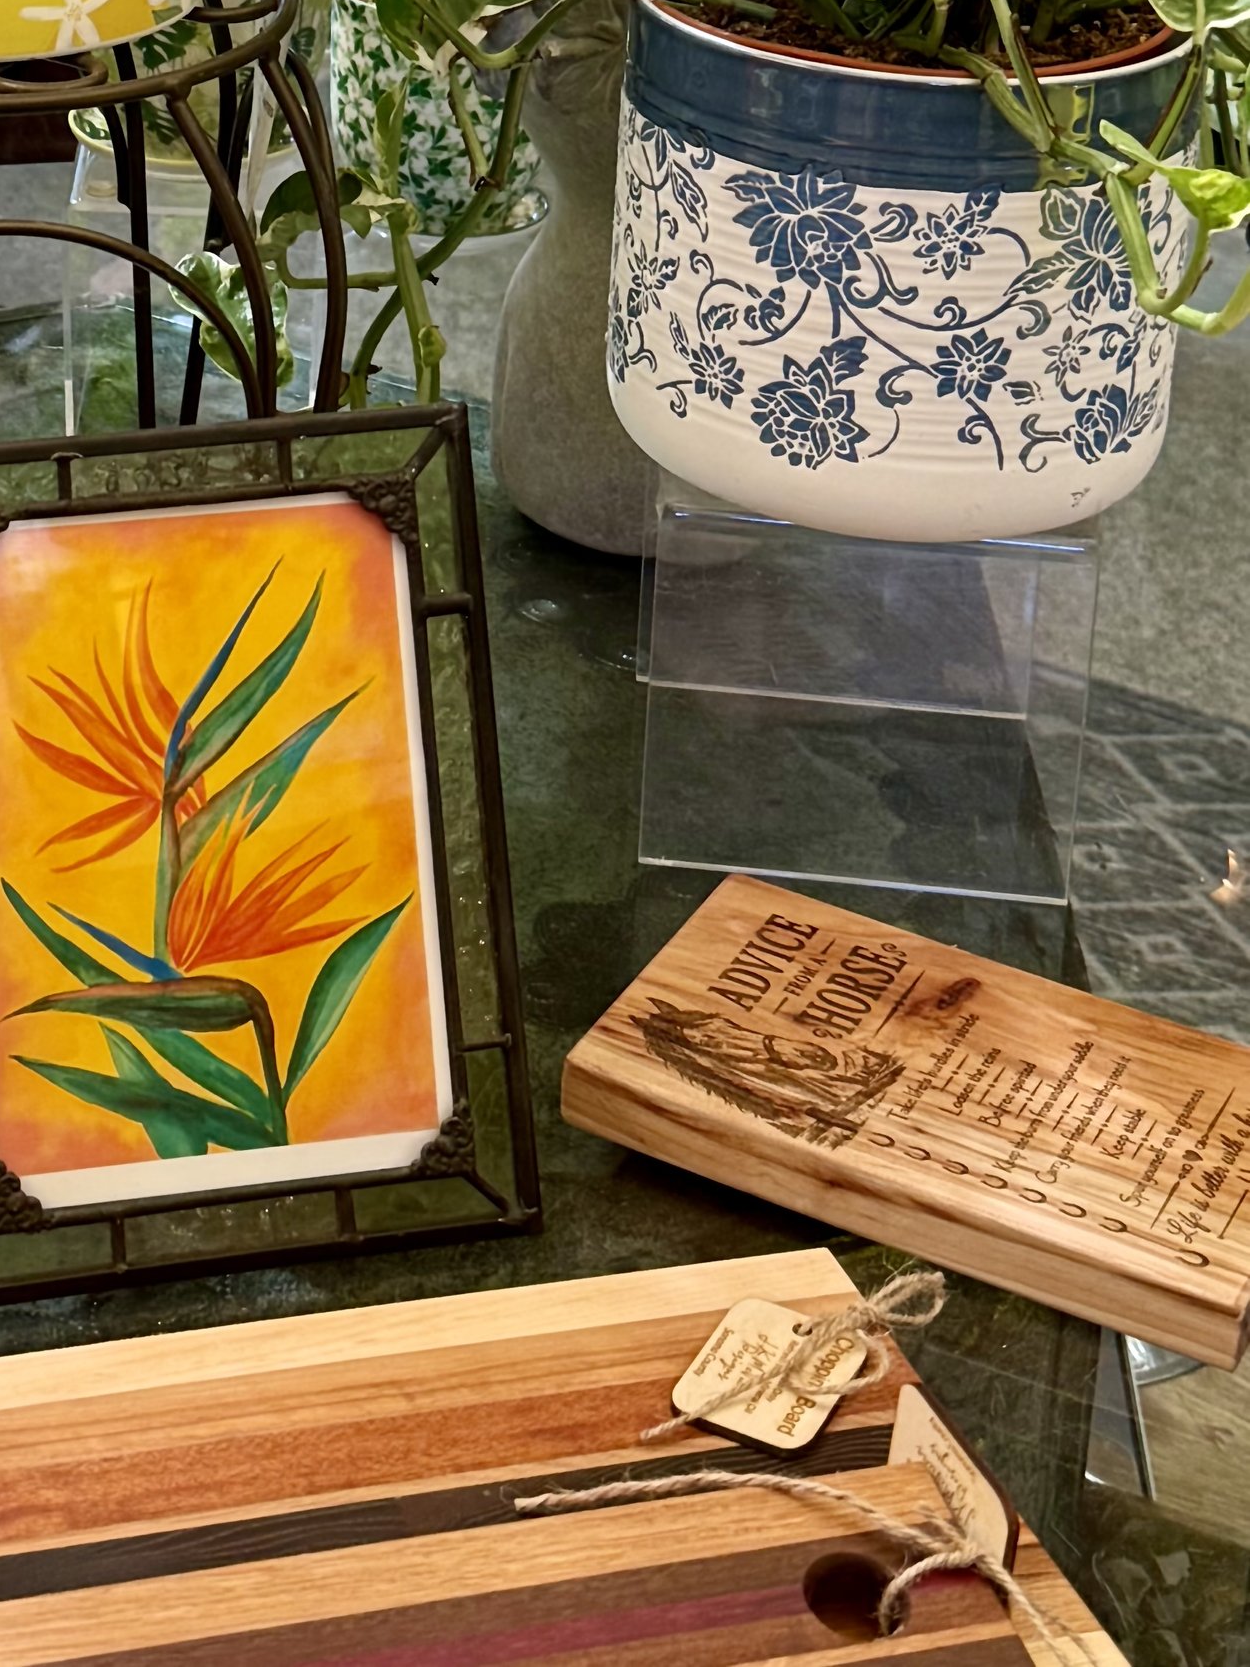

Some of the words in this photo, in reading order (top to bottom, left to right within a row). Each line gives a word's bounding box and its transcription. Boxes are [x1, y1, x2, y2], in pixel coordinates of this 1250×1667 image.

[706, 910, 819, 1014] ADVICE
[783, 963, 819, 997] FROM
[810, 955, 827, 968] A
[799, 941, 907, 1036] HORSE
[885, 1097, 917, 1121] Take
[954, 1012, 980, 1039] stride
[937, 1080, 976, 1116] Loosen
[980, 1046, 1002, 1069] reins
[1009, 1058, 1036, 1093] spirited
[991, 1149, 1026, 1171] Keep
[1070, 1039, 1095, 1064] saddle
[1098, 1133, 1136, 1160] Keep
[1122, 1106, 1146, 1134] stable
[1034, 1158, 1071, 1183] Carry
[1117, 1182, 1149, 1208] Spur
[1141, 1144, 1168, 1185] yourself
[1177, 1088, 1206, 1128] greatness
[1161, 1210, 1211, 1245] Life
[1189, 1165, 1230, 1198] better
[1219, 1132, 1246, 1166] with
[692, 1352, 717, 1377] County
[775, 1394, 817, 1437] Board
